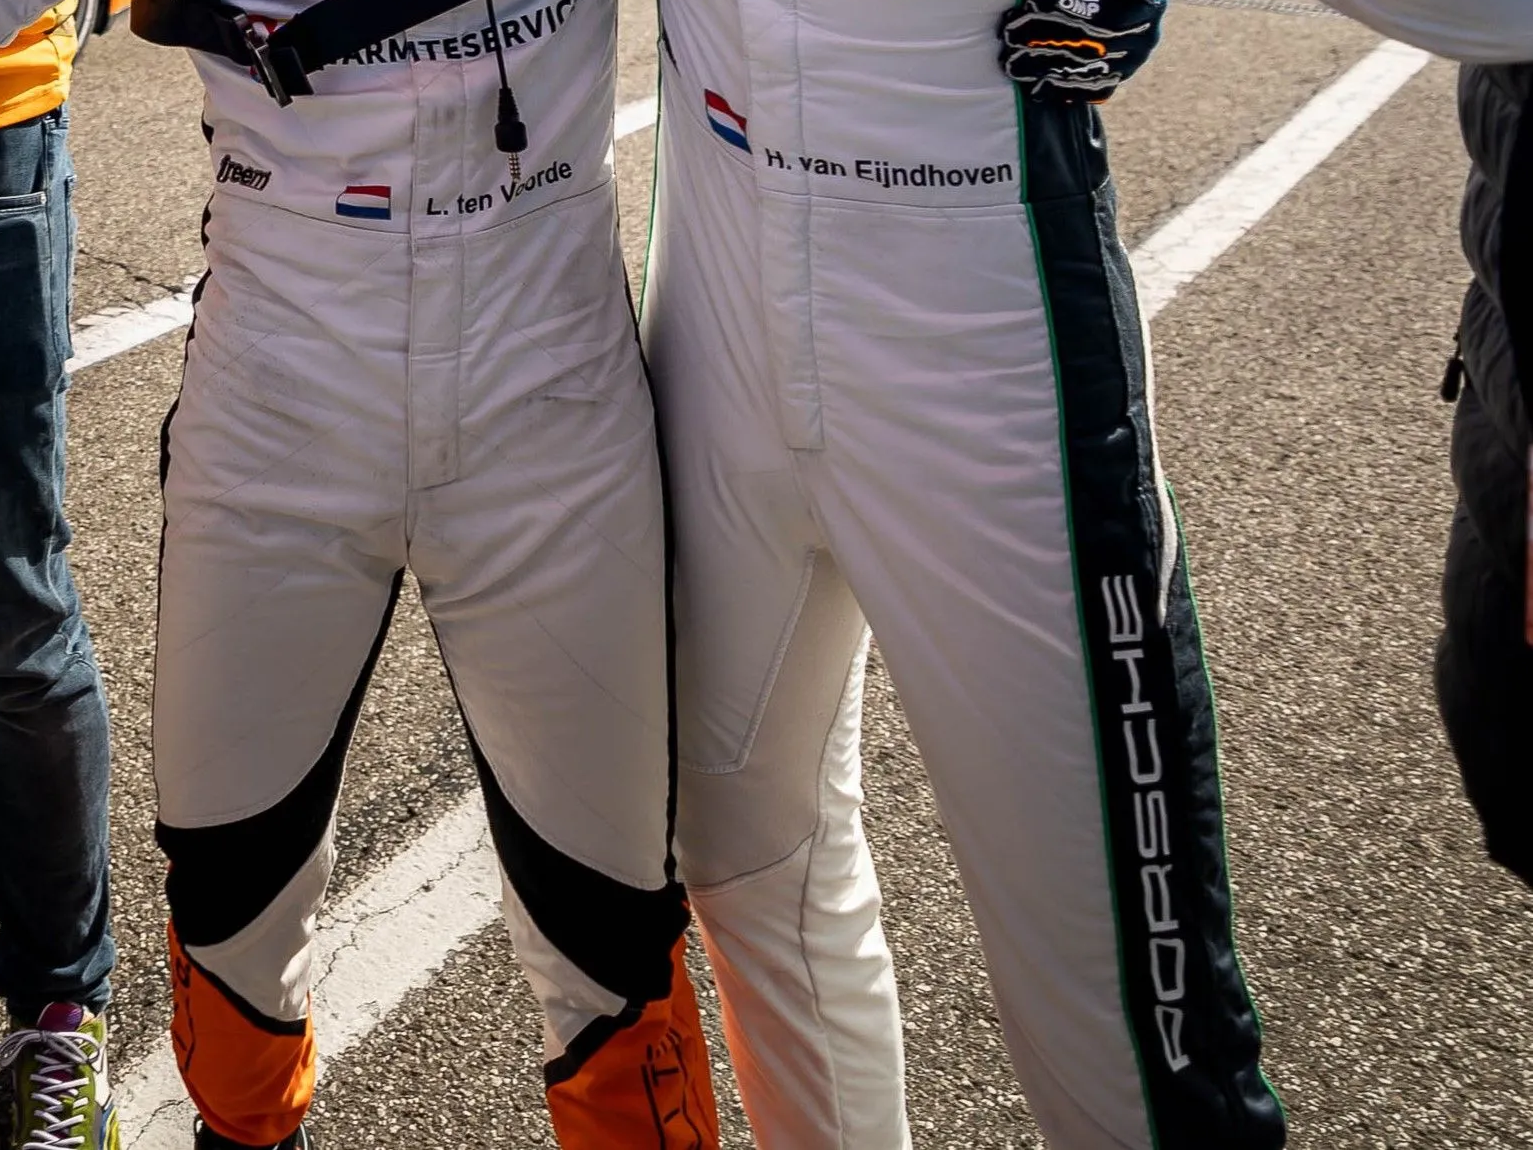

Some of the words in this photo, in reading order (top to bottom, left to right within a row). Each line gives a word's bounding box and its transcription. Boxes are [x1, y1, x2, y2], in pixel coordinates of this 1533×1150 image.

[216, 155, 273, 191] freem
[766, 147, 793, 170] H.
[799, 158, 847, 177] van
[855, 158, 1014, 187] Eijndhoven
[426, 198, 449, 216] L.
[456, 191, 494, 215] ten
[1101, 573, 1191, 1072] PORSCHE
